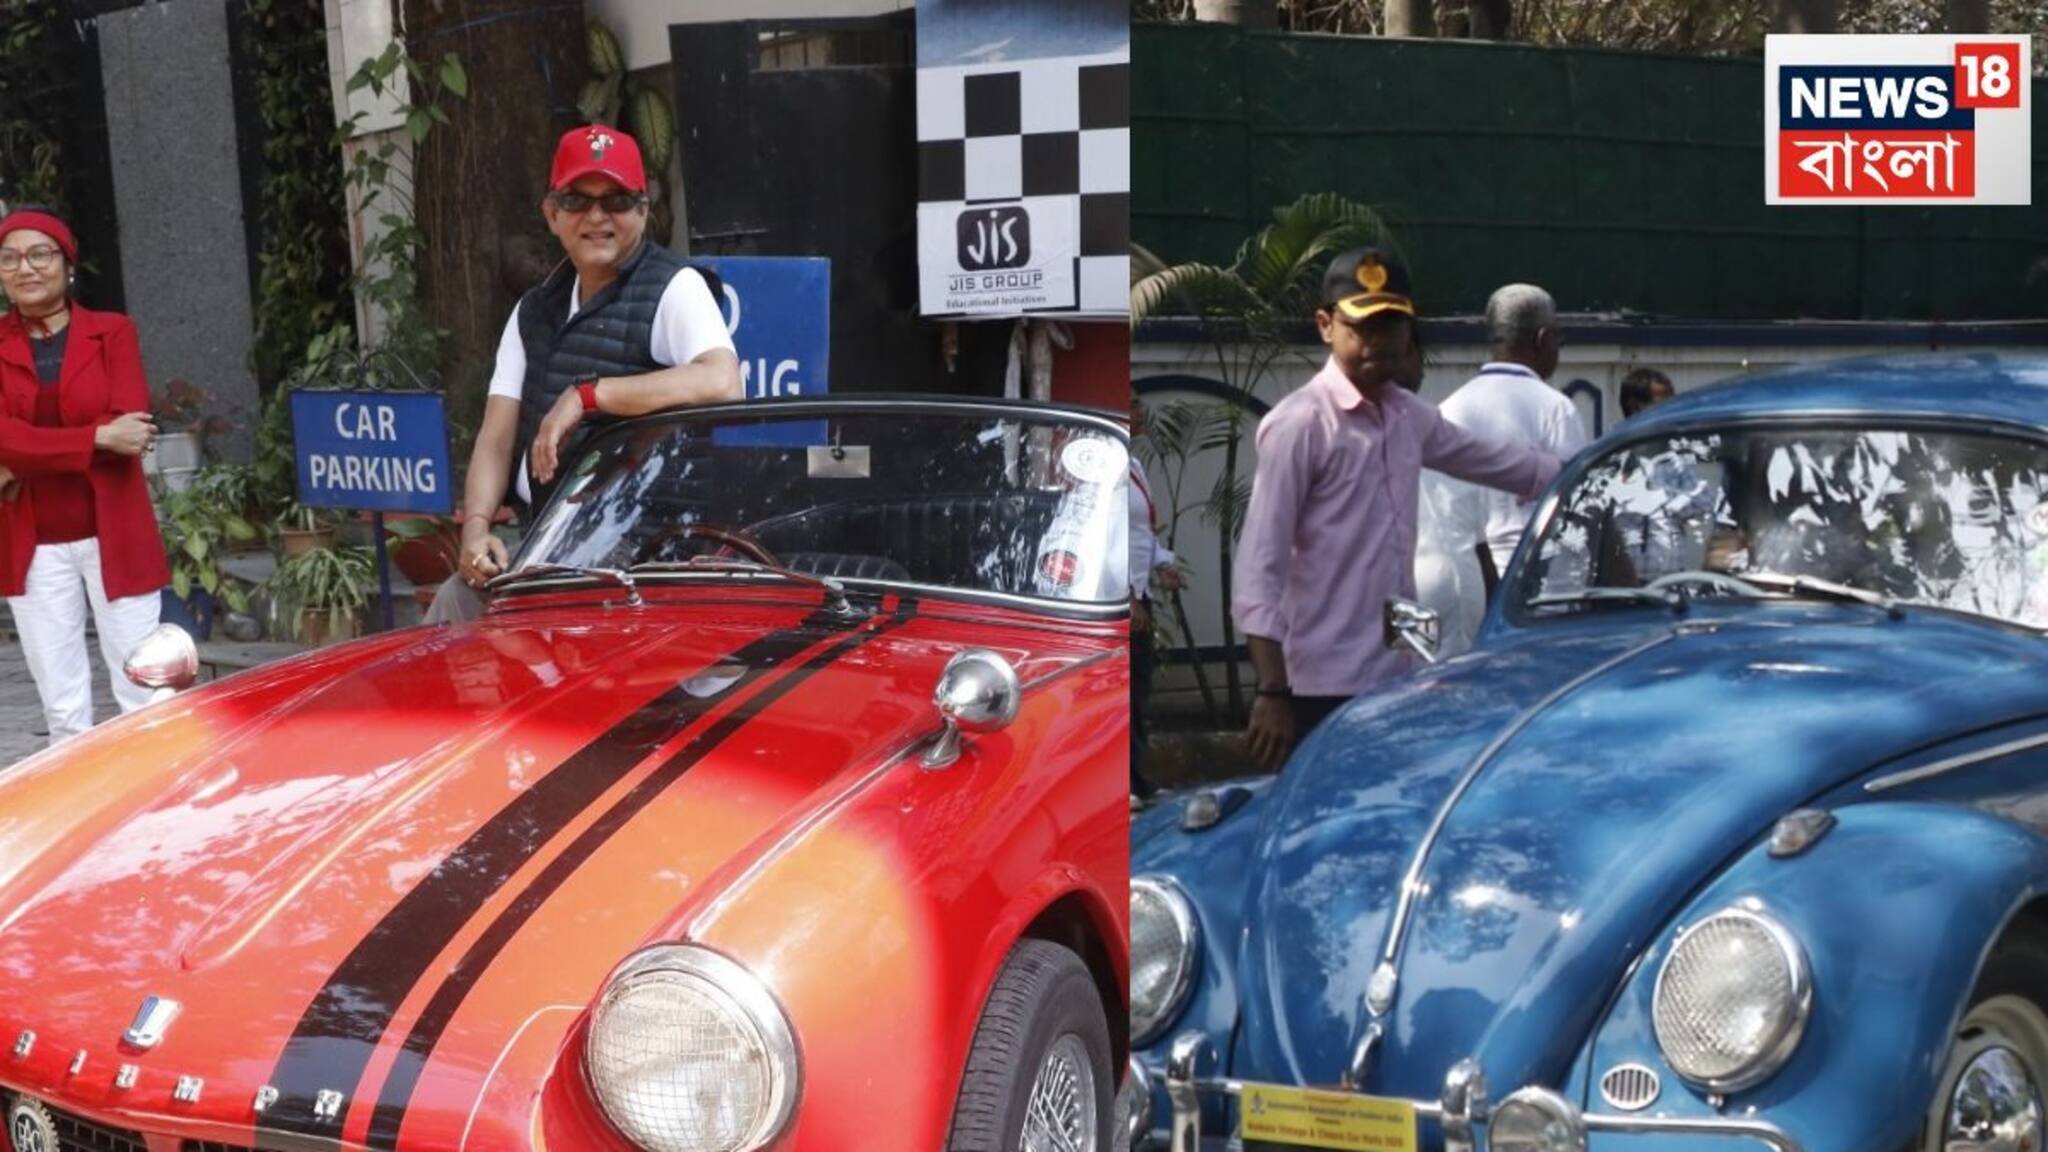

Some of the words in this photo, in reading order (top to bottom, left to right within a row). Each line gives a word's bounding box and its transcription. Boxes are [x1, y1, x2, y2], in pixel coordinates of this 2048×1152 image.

[950, 277, 975, 291] JIS
[983, 272, 1043, 289] GROUP
[335, 403, 397, 441] CAR
[309, 454, 436, 493] PARKING
